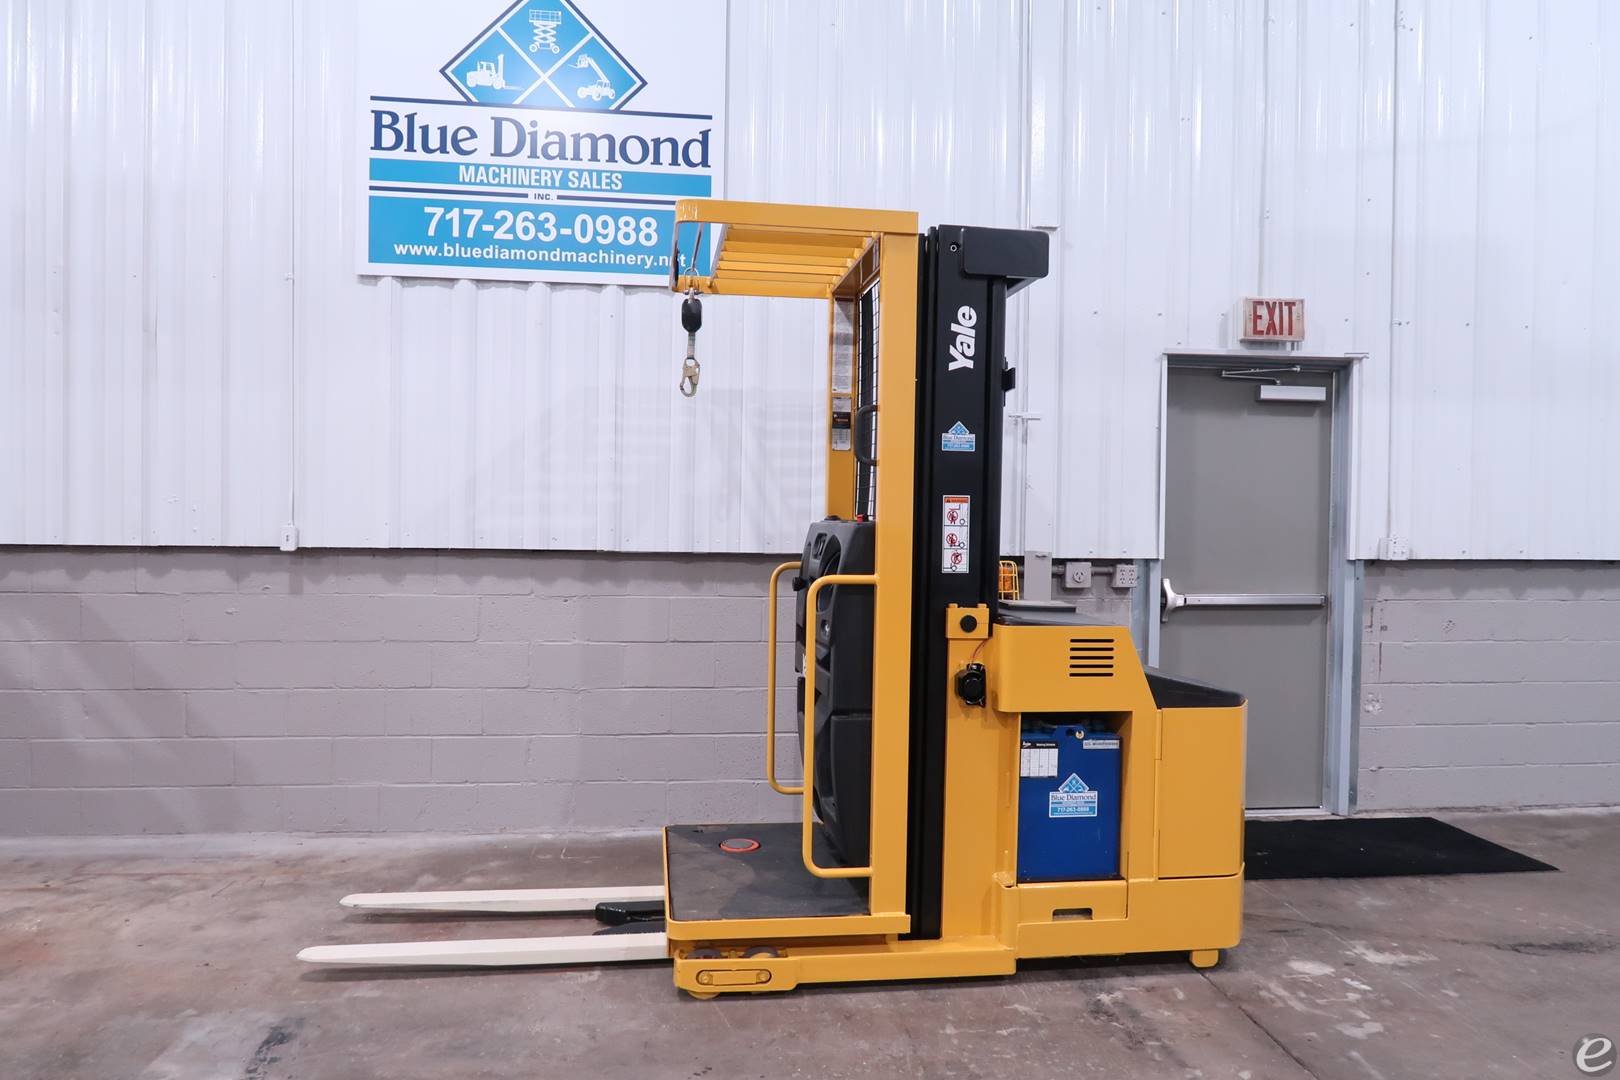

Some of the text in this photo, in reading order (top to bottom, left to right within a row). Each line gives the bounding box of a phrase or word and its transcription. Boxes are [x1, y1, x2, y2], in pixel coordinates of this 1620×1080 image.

[370, 109, 712, 168] Blue Diamond
[459, 164, 623, 190] MACHINERY SALES
[533, 193, 554, 201] INC.
[424, 206, 658, 247] 717-263-0988
[394, 242, 686, 270] www.bluediamondmachinery.nt
[1252, 300, 1297, 336] EXIT
[948, 305, 977, 371] Yale
